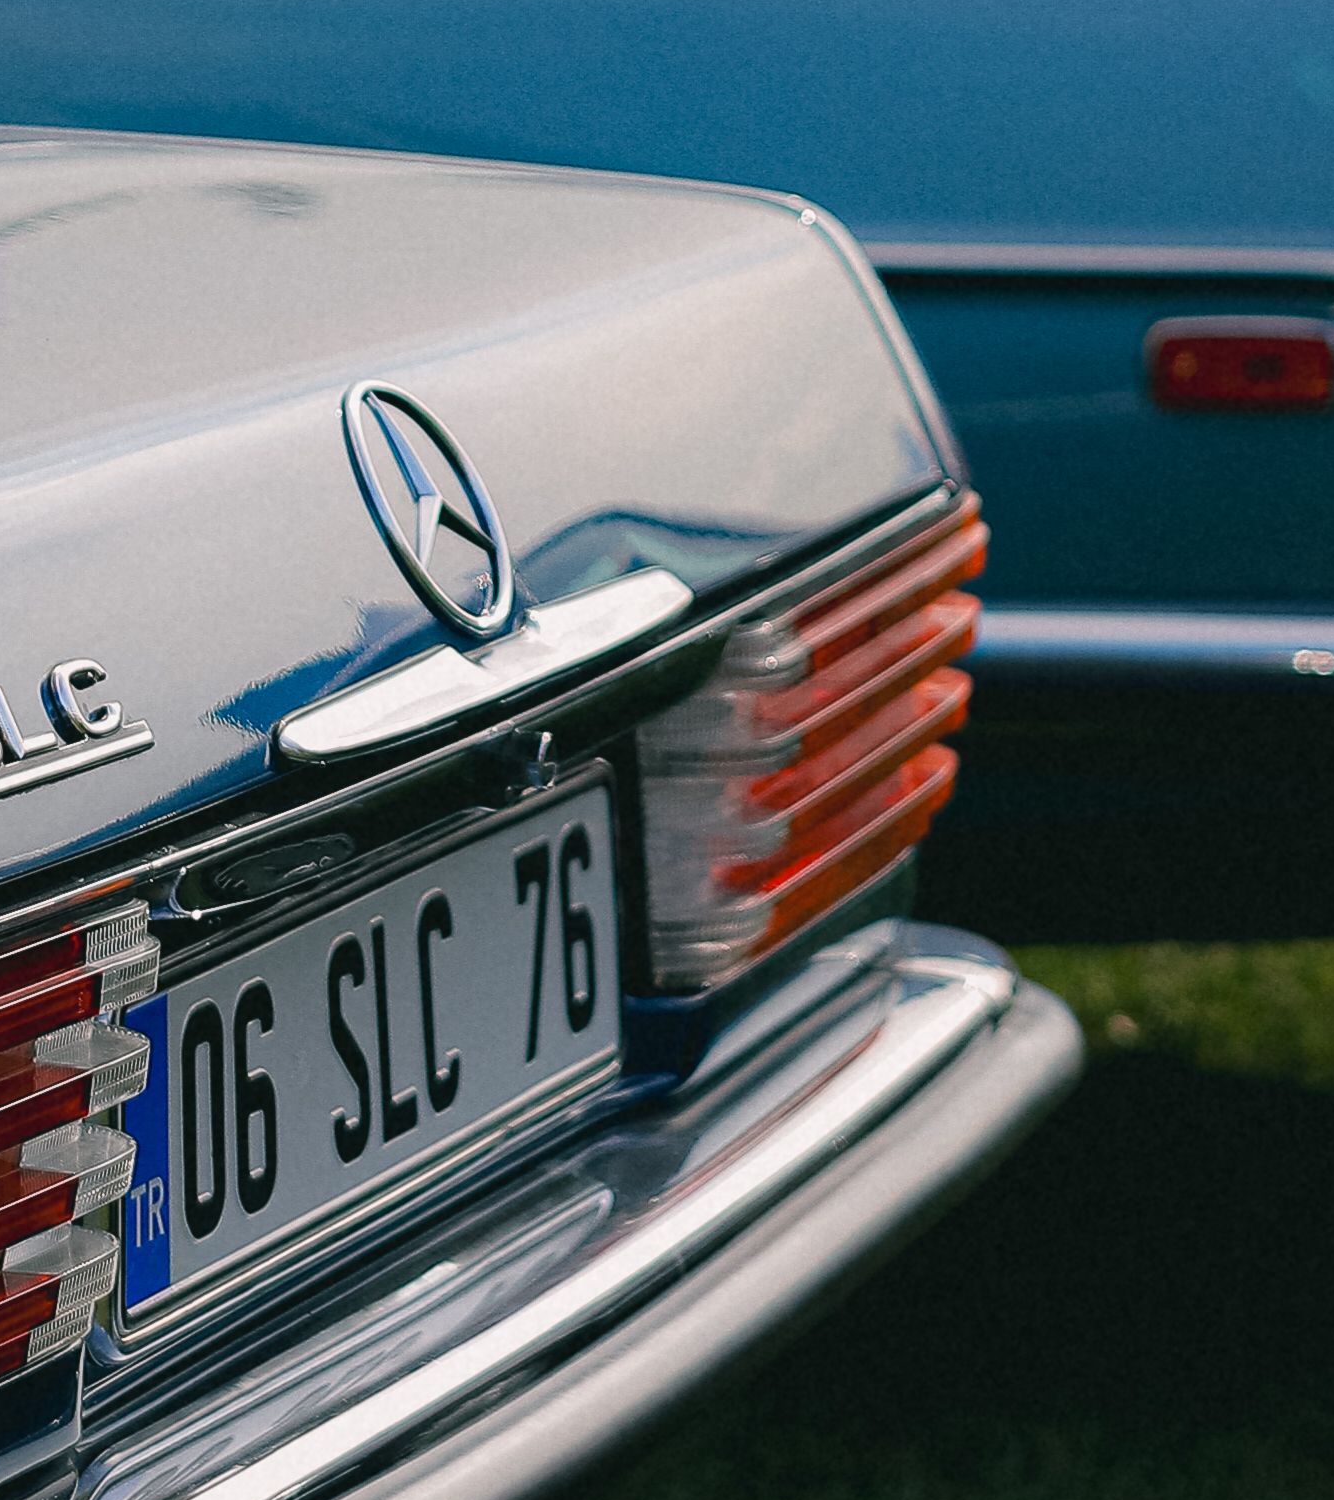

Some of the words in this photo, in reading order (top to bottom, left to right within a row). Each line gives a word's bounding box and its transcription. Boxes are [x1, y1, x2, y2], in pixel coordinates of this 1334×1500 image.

[180, 976, 278, 1241] 06
[326, 887, 462, 1165] SLC
[513, 822, 597, 1063] 76
[130, 1176, 165, 1249] TR
